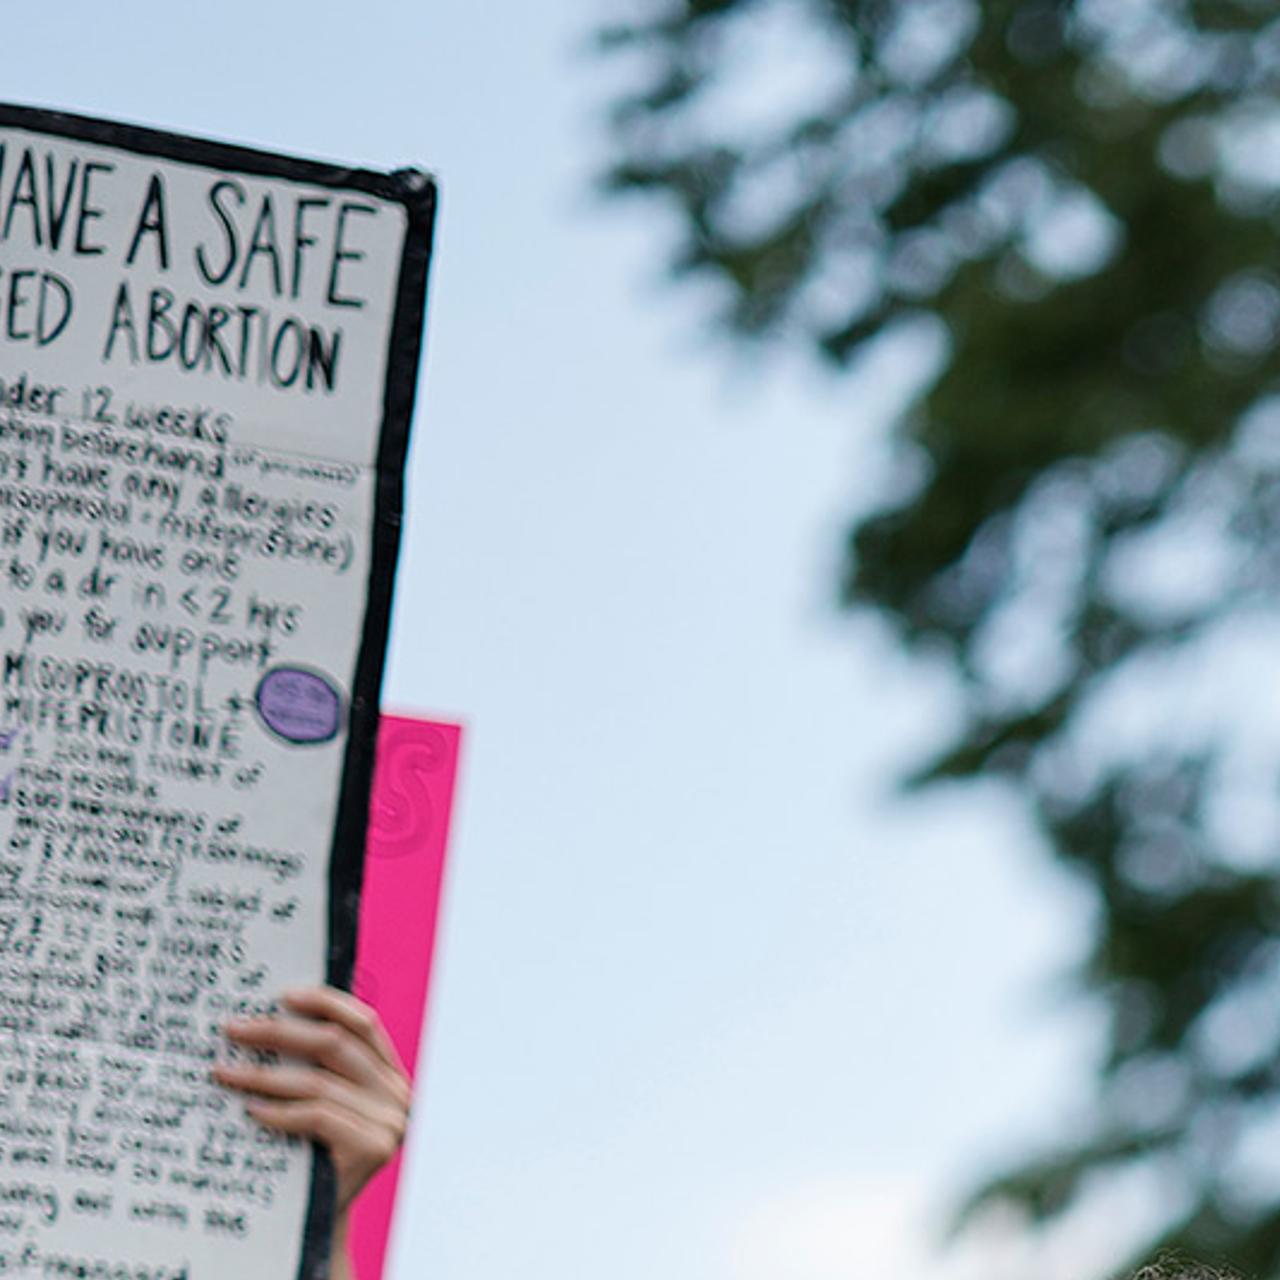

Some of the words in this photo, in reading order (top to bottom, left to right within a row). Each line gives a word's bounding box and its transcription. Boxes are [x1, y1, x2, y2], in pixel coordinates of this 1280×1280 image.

[0, 144, 116, 256] AVE
[126, 173, 169, 270] A
[195, 180, 378, 309] SAFE
[103, 282, 342, 393] ABORTION
